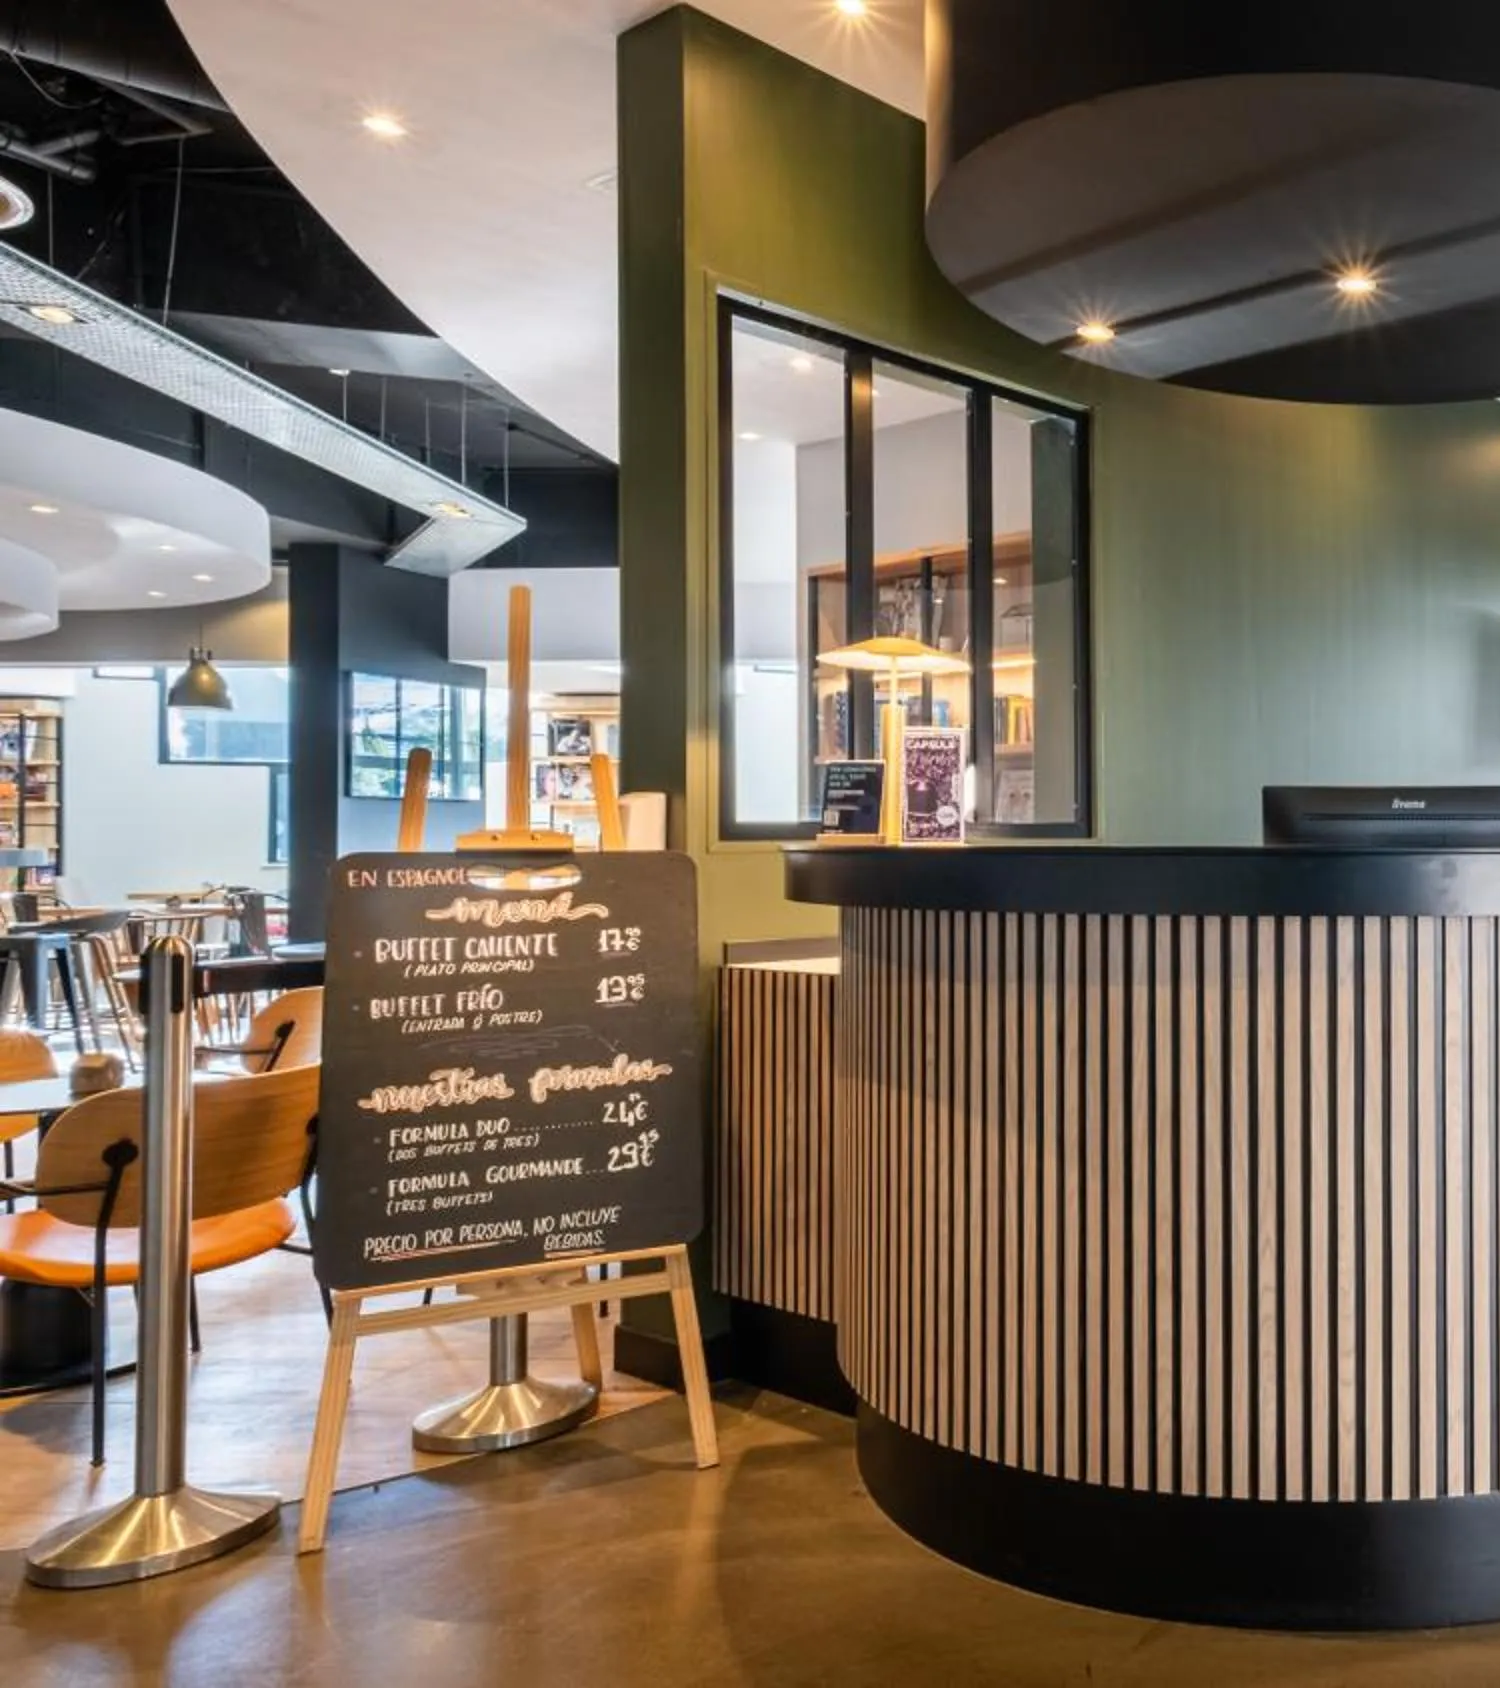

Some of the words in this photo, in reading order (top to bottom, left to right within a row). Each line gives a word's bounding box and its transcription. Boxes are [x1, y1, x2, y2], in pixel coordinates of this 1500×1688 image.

[348, 869, 378, 888] EN
[386, 867, 470, 888] ESPAGNOL
[375, 937, 457, 964] BUFFET
[465, 933, 559, 960] CALIENTE
[370, 994, 446, 1019] BUFFET
[457, 983, 504, 1013] FRÍO
[389, 1122, 470, 1148] FORMULA
[475, 1117, 511, 1137] DUO
[387, 1171, 471, 1197] FORMULA
[485, 1157, 584, 1184] GOURMANDE
[363, 1233, 417, 1259] PRECIO
[424, 1227, 453, 1249] POR
[533, 1215, 555, 1236] NO
[559, 1205, 623, 1230] INCLUYE
